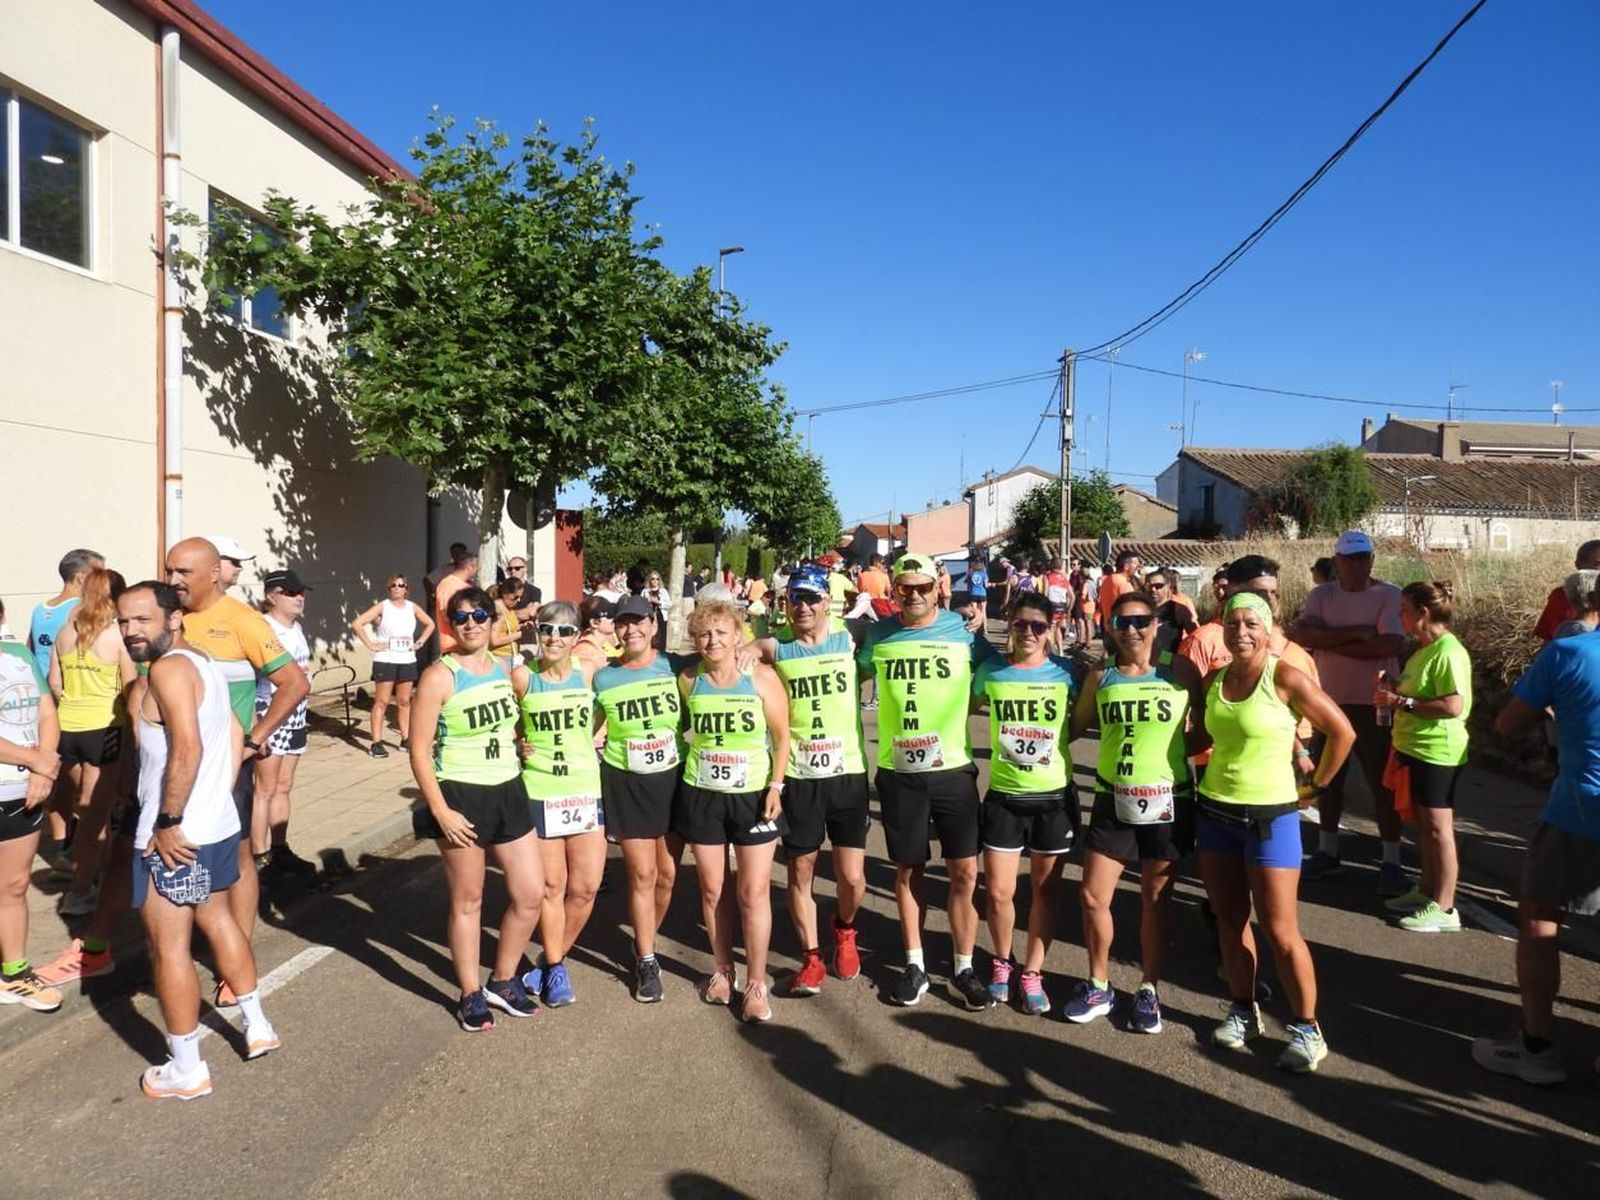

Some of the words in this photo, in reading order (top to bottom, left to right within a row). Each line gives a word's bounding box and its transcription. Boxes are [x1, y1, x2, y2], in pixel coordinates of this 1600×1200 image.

[1015, 740, 1036, 755] 36
[645, 749, 665, 764] 38
[810, 753, 830, 768] 40
[905, 749, 926, 763] 39
[711, 765, 731, 780] 35
[1137, 798, 1149, 814] 9
[562, 809, 582, 824] 34
